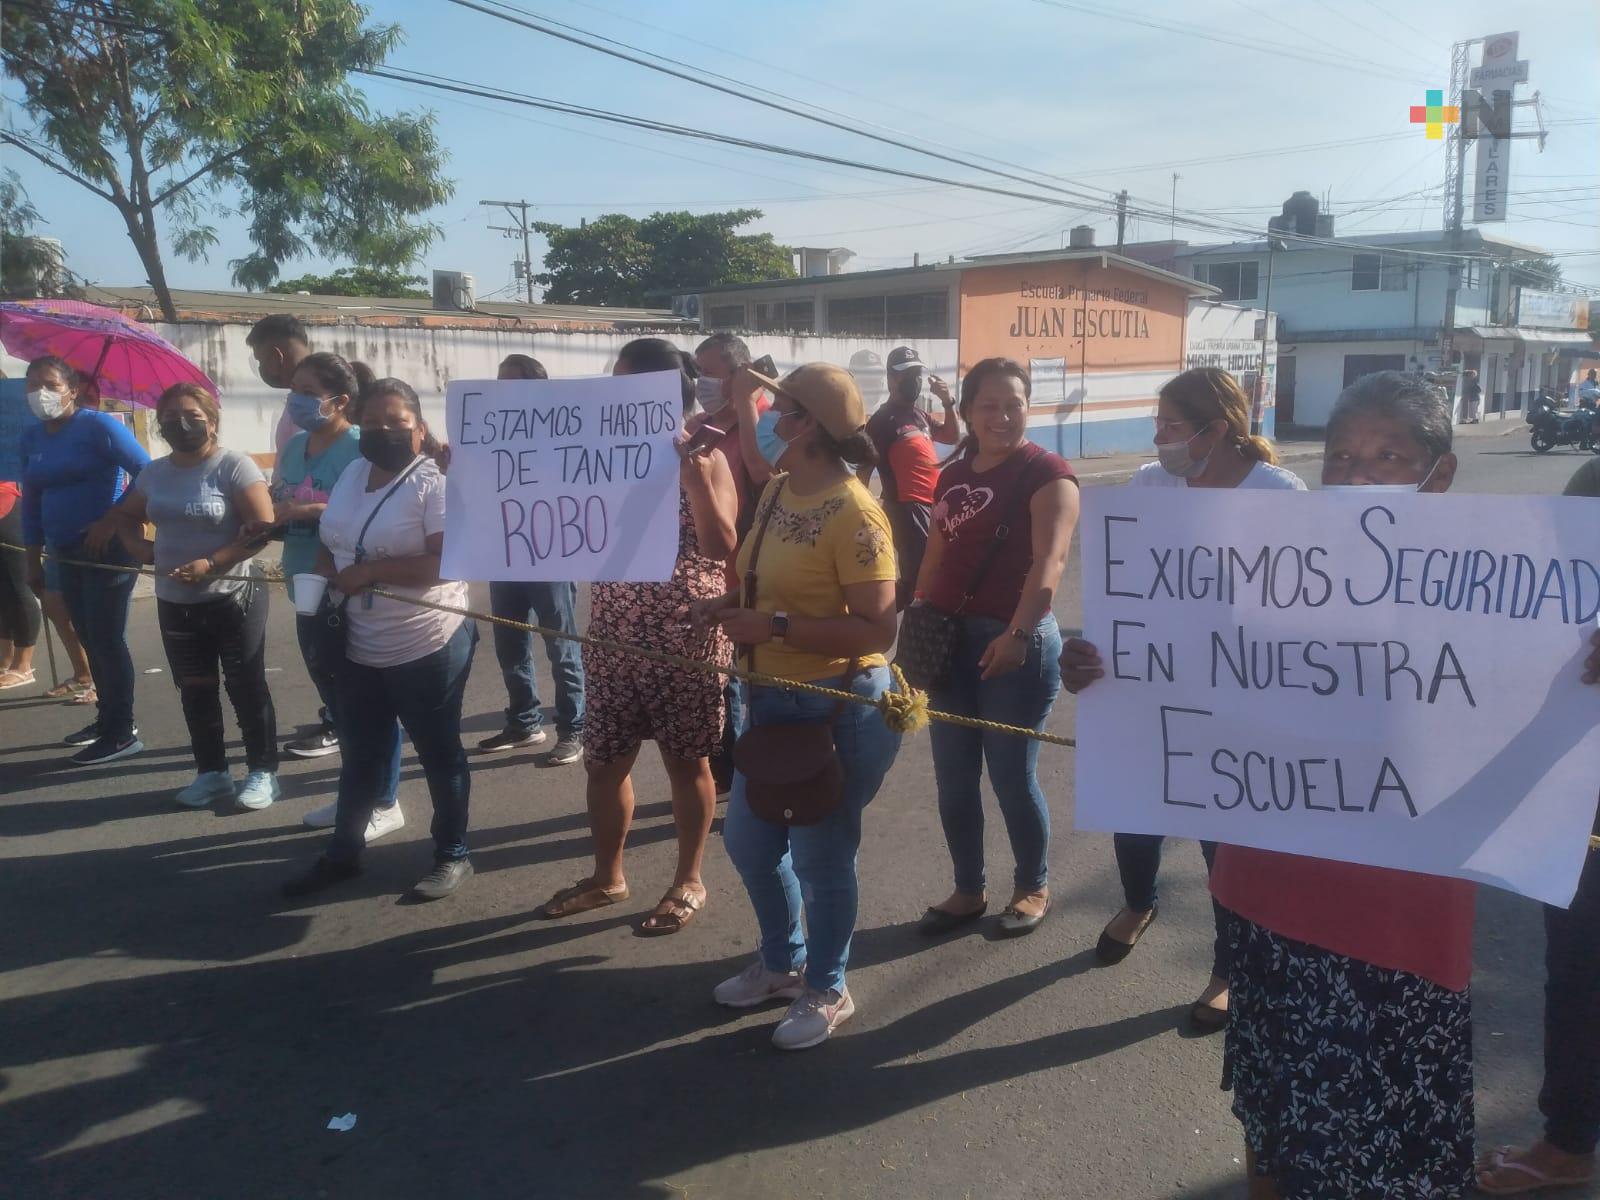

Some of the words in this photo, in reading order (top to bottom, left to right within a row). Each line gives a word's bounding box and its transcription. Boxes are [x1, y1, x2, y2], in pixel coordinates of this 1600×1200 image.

[1020, 282, 1065, 300] Escuela
[1114, 288, 1149, 305] Federal
[1009, 305, 1067, 338] JUAN
[1072, 307, 1151, 339] ESCUTIA
[1187, 353, 1223, 369] MIGUEL
[1228, 354, 1264, 371] HIDALG
[460, 392, 583, 446] ESTAMOS
[600, 400, 676, 437] HARTOS
[491, 449, 539, 493] DE
[554, 442, 652, 485] TANTO
[501, 495, 608, 568] ROBO
[1104, 515, 1333, 609] EXIGIMOS
[1345, 505, 1600, 625] SEGURIDAD
[1112, 620, 1175, 682] EN
[1210, 626, 1477, 708] NUESTRA
[1160, 705, 1418, 818] ESCUELA
